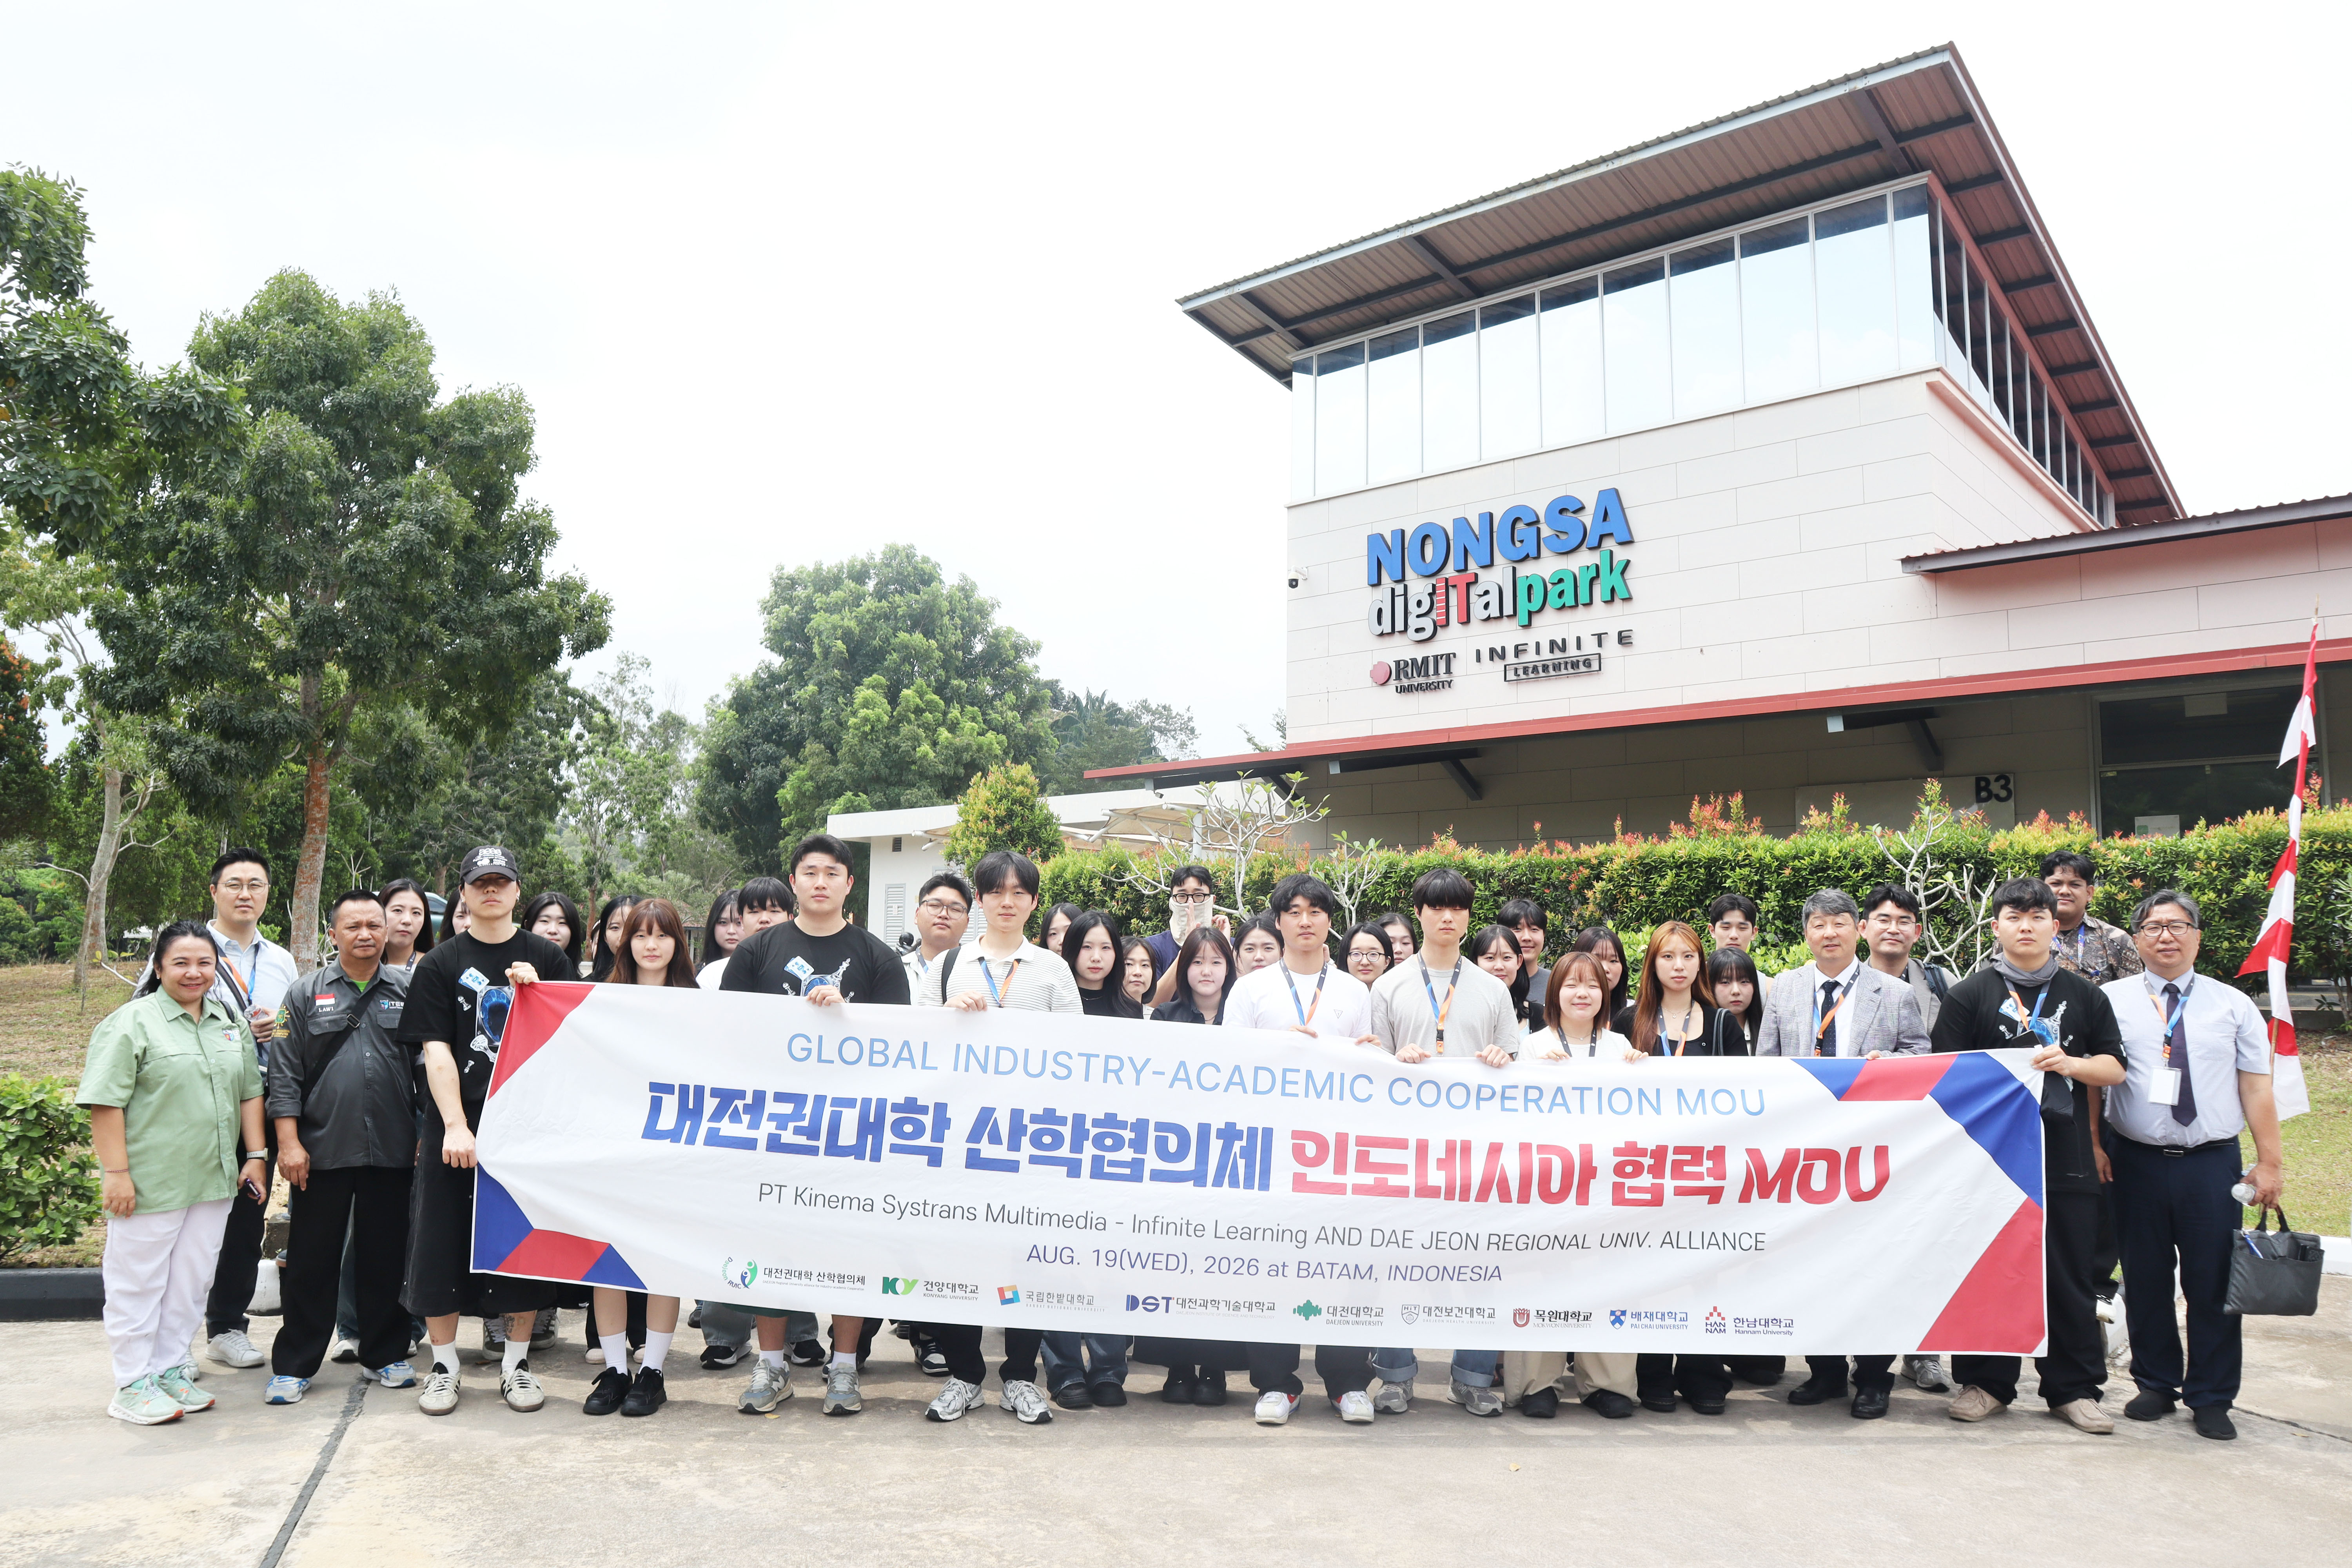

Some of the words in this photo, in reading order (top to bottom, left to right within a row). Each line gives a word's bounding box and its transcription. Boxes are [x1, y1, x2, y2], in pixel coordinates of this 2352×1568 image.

[1367, 488, 1635, 586] NONGSA
[1476, 629, 1633, 663] INFINITE
[1393, 652, 1456, 681] RMIT
[1514, 658, 1592, 677] LEARNING
[1395, 679, 1454, 694] UNIVERSITY
[1975, 775, 2013, 803] B3
[787, 1033, 938, 1071] GLOBAL
[953, 1044, 1374, 1103] INDUSTRY-ACADEMIC
[1388, 1077, 1661, 1115] COOPERATION
[1677, 1088, 1765, 1116] MOU
[641, 1082, 951, 1168] 대전권대학
[964, 1106, 1273, 1192] 산학협의체
[1291, 1129, 1598, 1206] 인도네시아
[1612, 1140, 1727, 1207] 협력
[1737, 1145, 1890, 1205] MOU
[759, 1183, 788, 1204] PT
[794, 1186, 874, 1212] Kinema
[882, 1194, 977, 1221] Systrans
[985, 1203, 1107, 1231] Multimedia
[1132, 1214, 1205, 1238] Infinite
[1214, 1219, 1307, 1249] Learning
[1314, 1225, 1362, 1246] AND
[1370, 1228, 1414, 1249] DAE
[1421, 1231, 1479, 1251] JEON
[1486, 1233, 1592, 1251] REGIONAL
[1599, 1231, 1651, 1249] UNIV.
[1660, 1230, 1766, 1251] ALLIANCE
[722, 1257, 733, 1280] Daejeon
[1026, 1244, 1080, 1265] AUG.
[1092, 1248, 1194, 1275] 19(WED),
[1204, 1256, 1259, 1276] 2026
[1267, 1261, 1289, 1278] at
[1296, 1261, 1378, 1283] BATAM,
[1388, 1265, 1502, 1282] INDONESIA
[727, 1280, 741, 1289] RUIC
[763, 1267, 813, 1281] 대전권대학
[816, 1272, 866, 1285] 산학협의체
[882, 1276, 919, 1295] KY
[924, 1281, 979, 1294] 건양대학교
[1026, 1291, 1094, 1306] 국립한밭대학교
[1126, 1294, 1172, 1313] DST
[1176, 1298, 1276, 1313] 대전과학기술대학교
[1327, 1306, 1384, 1318] 대전대학교
[1423, 1306, 1495, 1319] 대전보건대학교
[1534, 1310, 1592, 1322] 목원대학교
[1631, 1311, 1688, 1322] 배재대학교
[1733, 1317, 1794, 1328] 한남대학교
